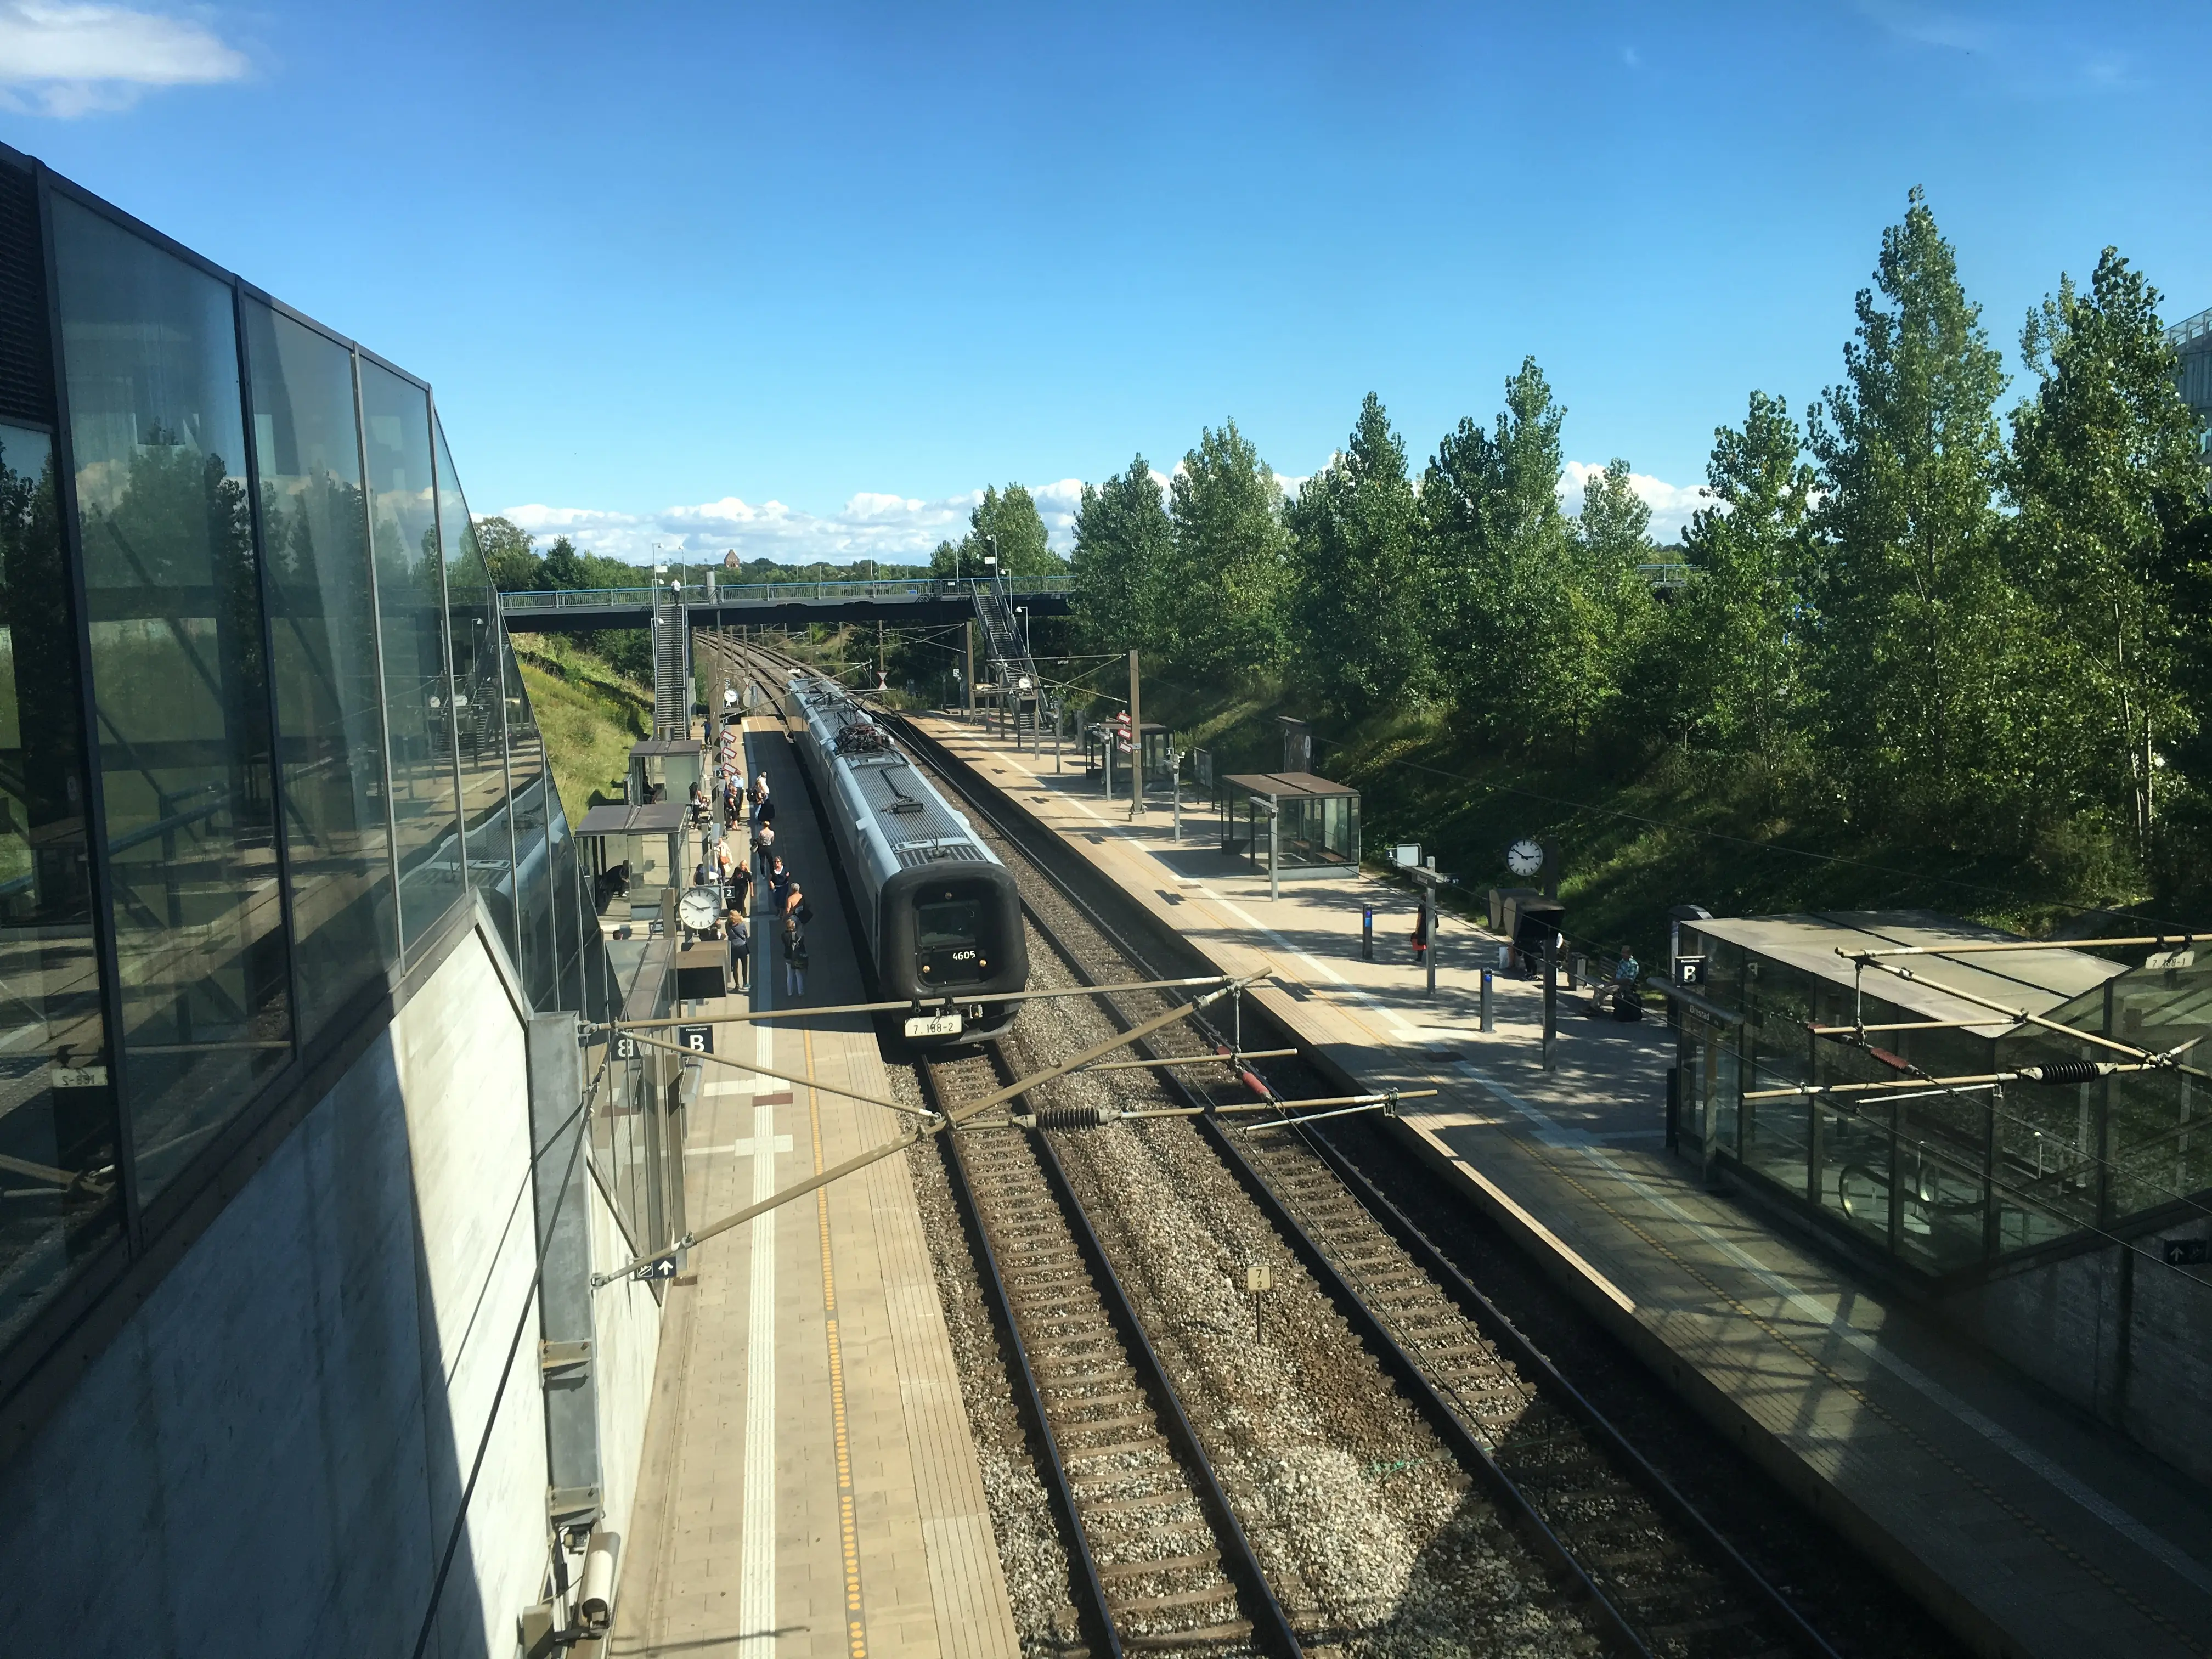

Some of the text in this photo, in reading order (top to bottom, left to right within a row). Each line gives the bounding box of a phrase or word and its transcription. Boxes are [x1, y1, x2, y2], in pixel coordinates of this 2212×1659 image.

[952, 950, 975, 960] 4605
[1684, 966, 1696, 982] B
[690, 1035, 705, 1052] B
[1256, 1269, 1262, 1278] 7
